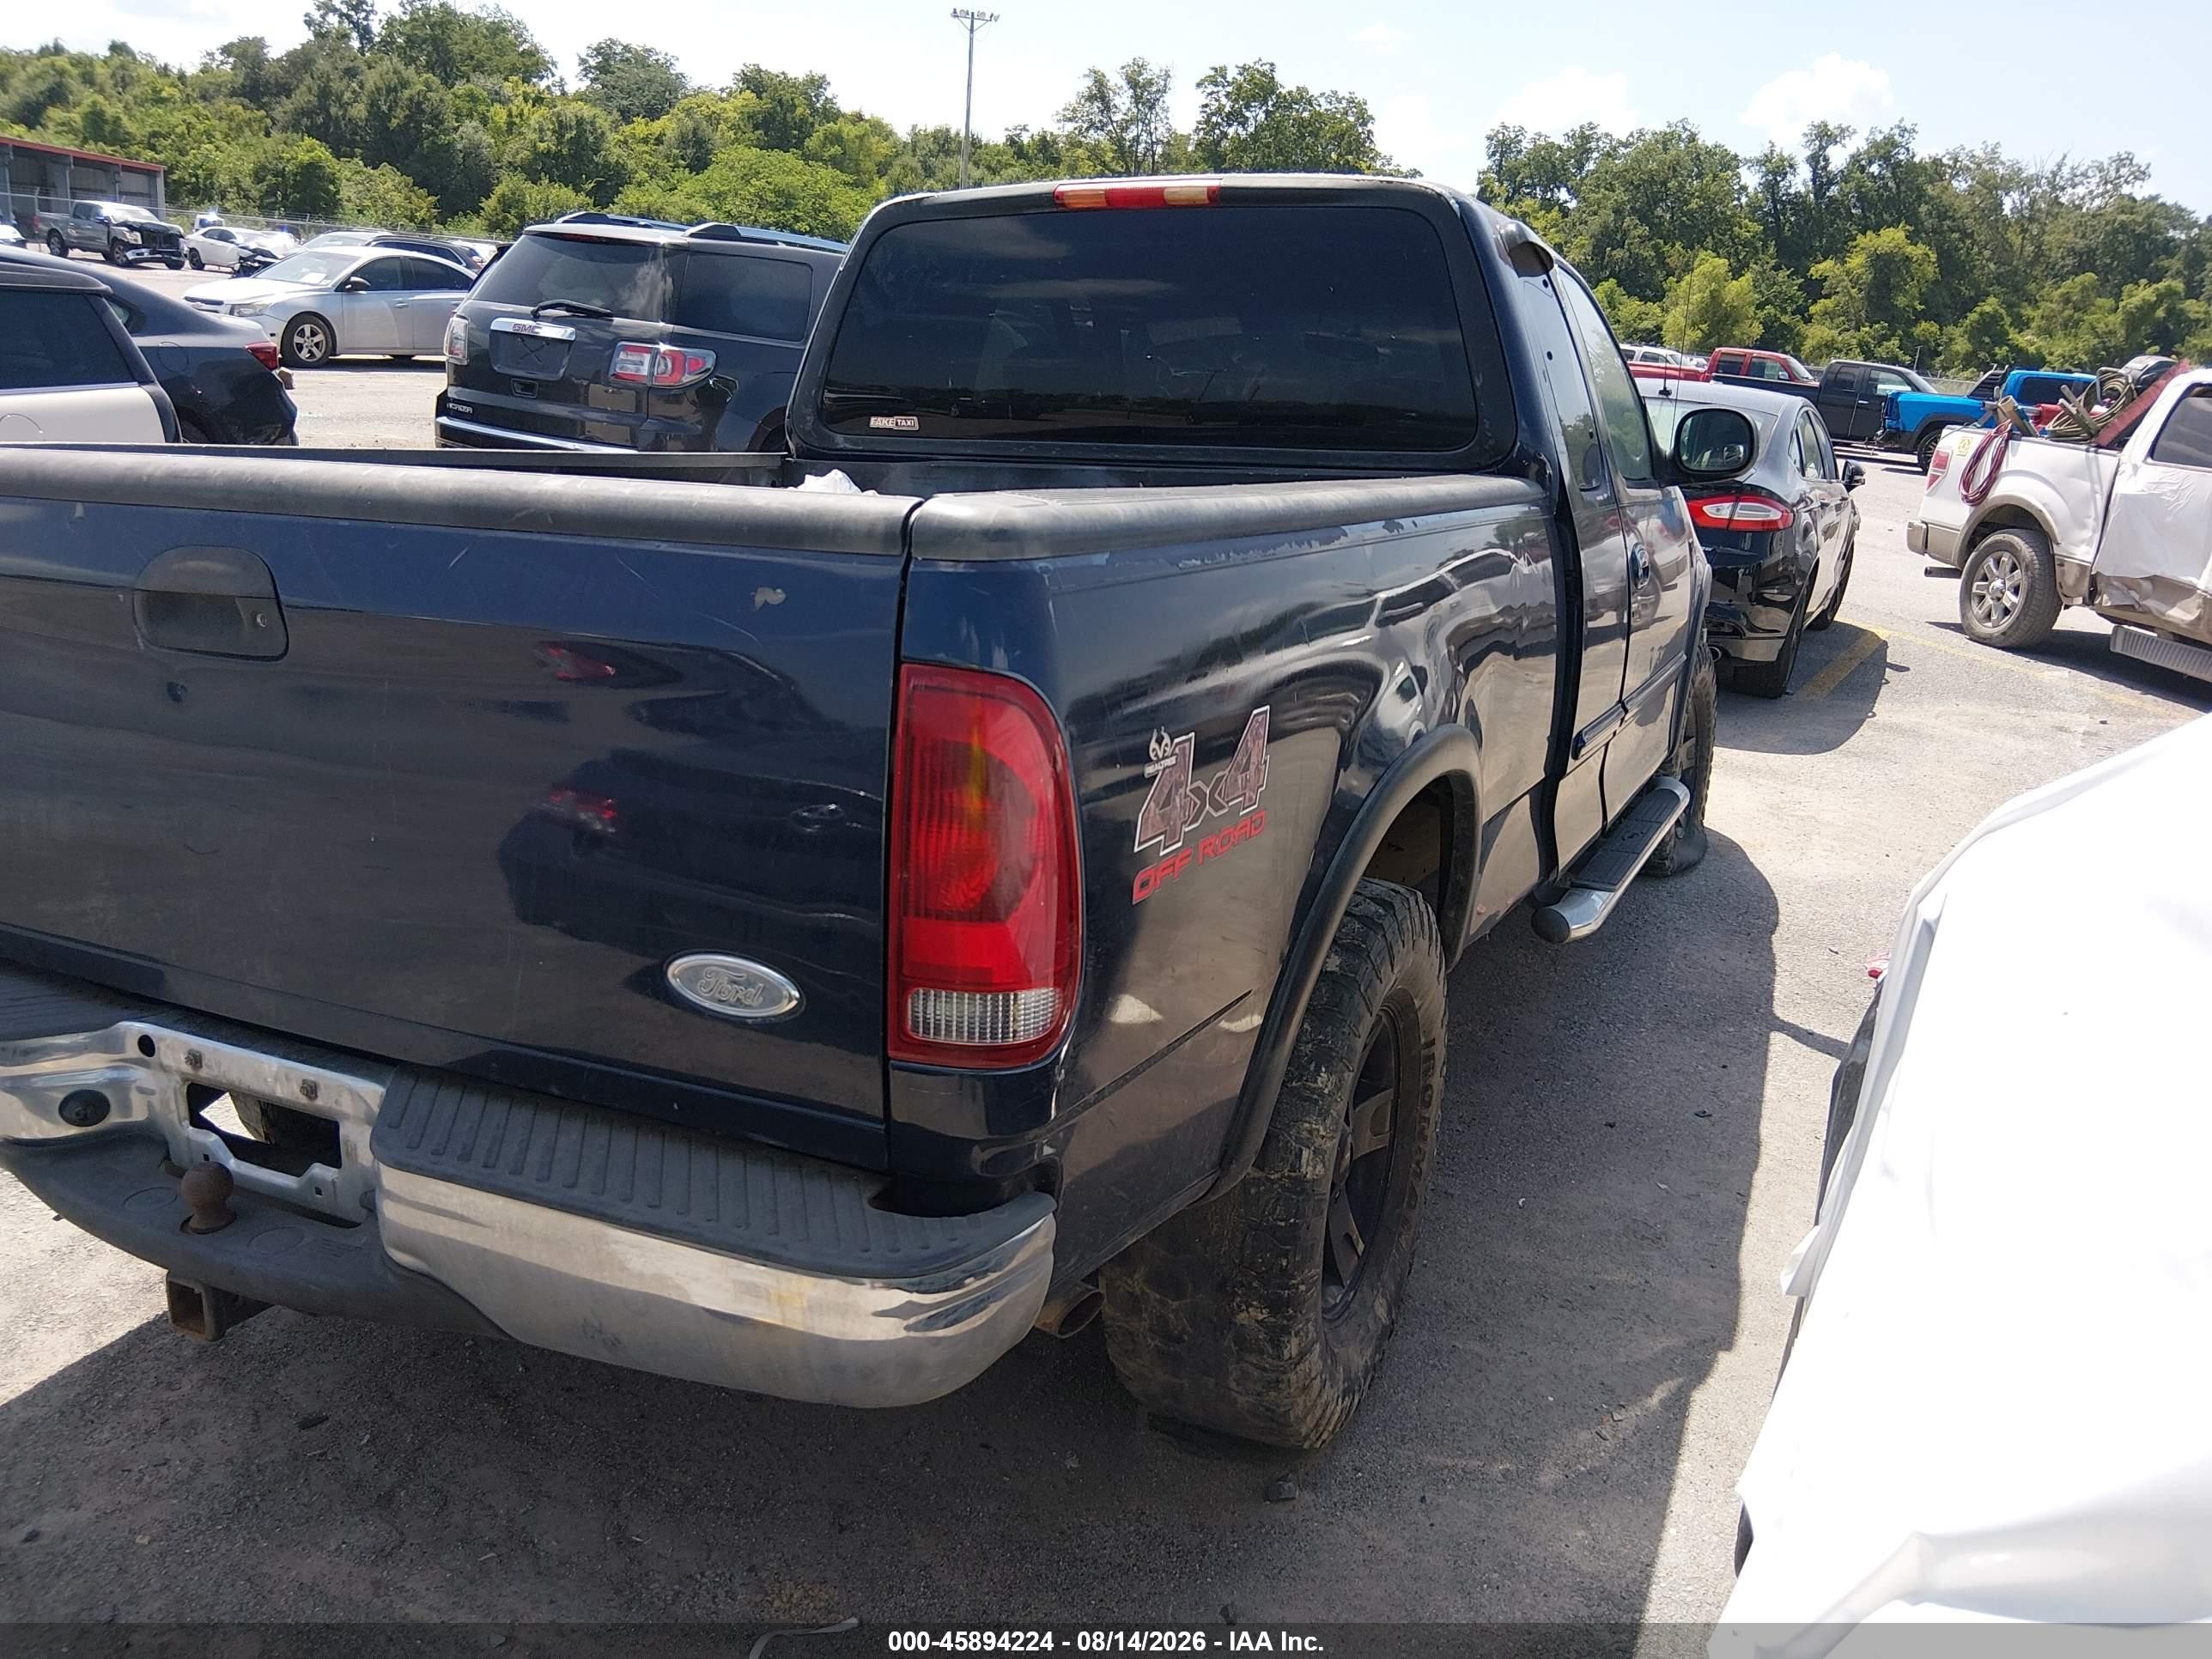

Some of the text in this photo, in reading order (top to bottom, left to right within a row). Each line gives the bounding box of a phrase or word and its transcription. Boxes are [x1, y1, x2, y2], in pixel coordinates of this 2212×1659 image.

[513, 323, 543, 334] GMC
[870, 416, 915, 427] FAKE TAXI
[1132, 810, 1267, 905] OFF ROAD
[697, 965, 763, 1006] Ford
